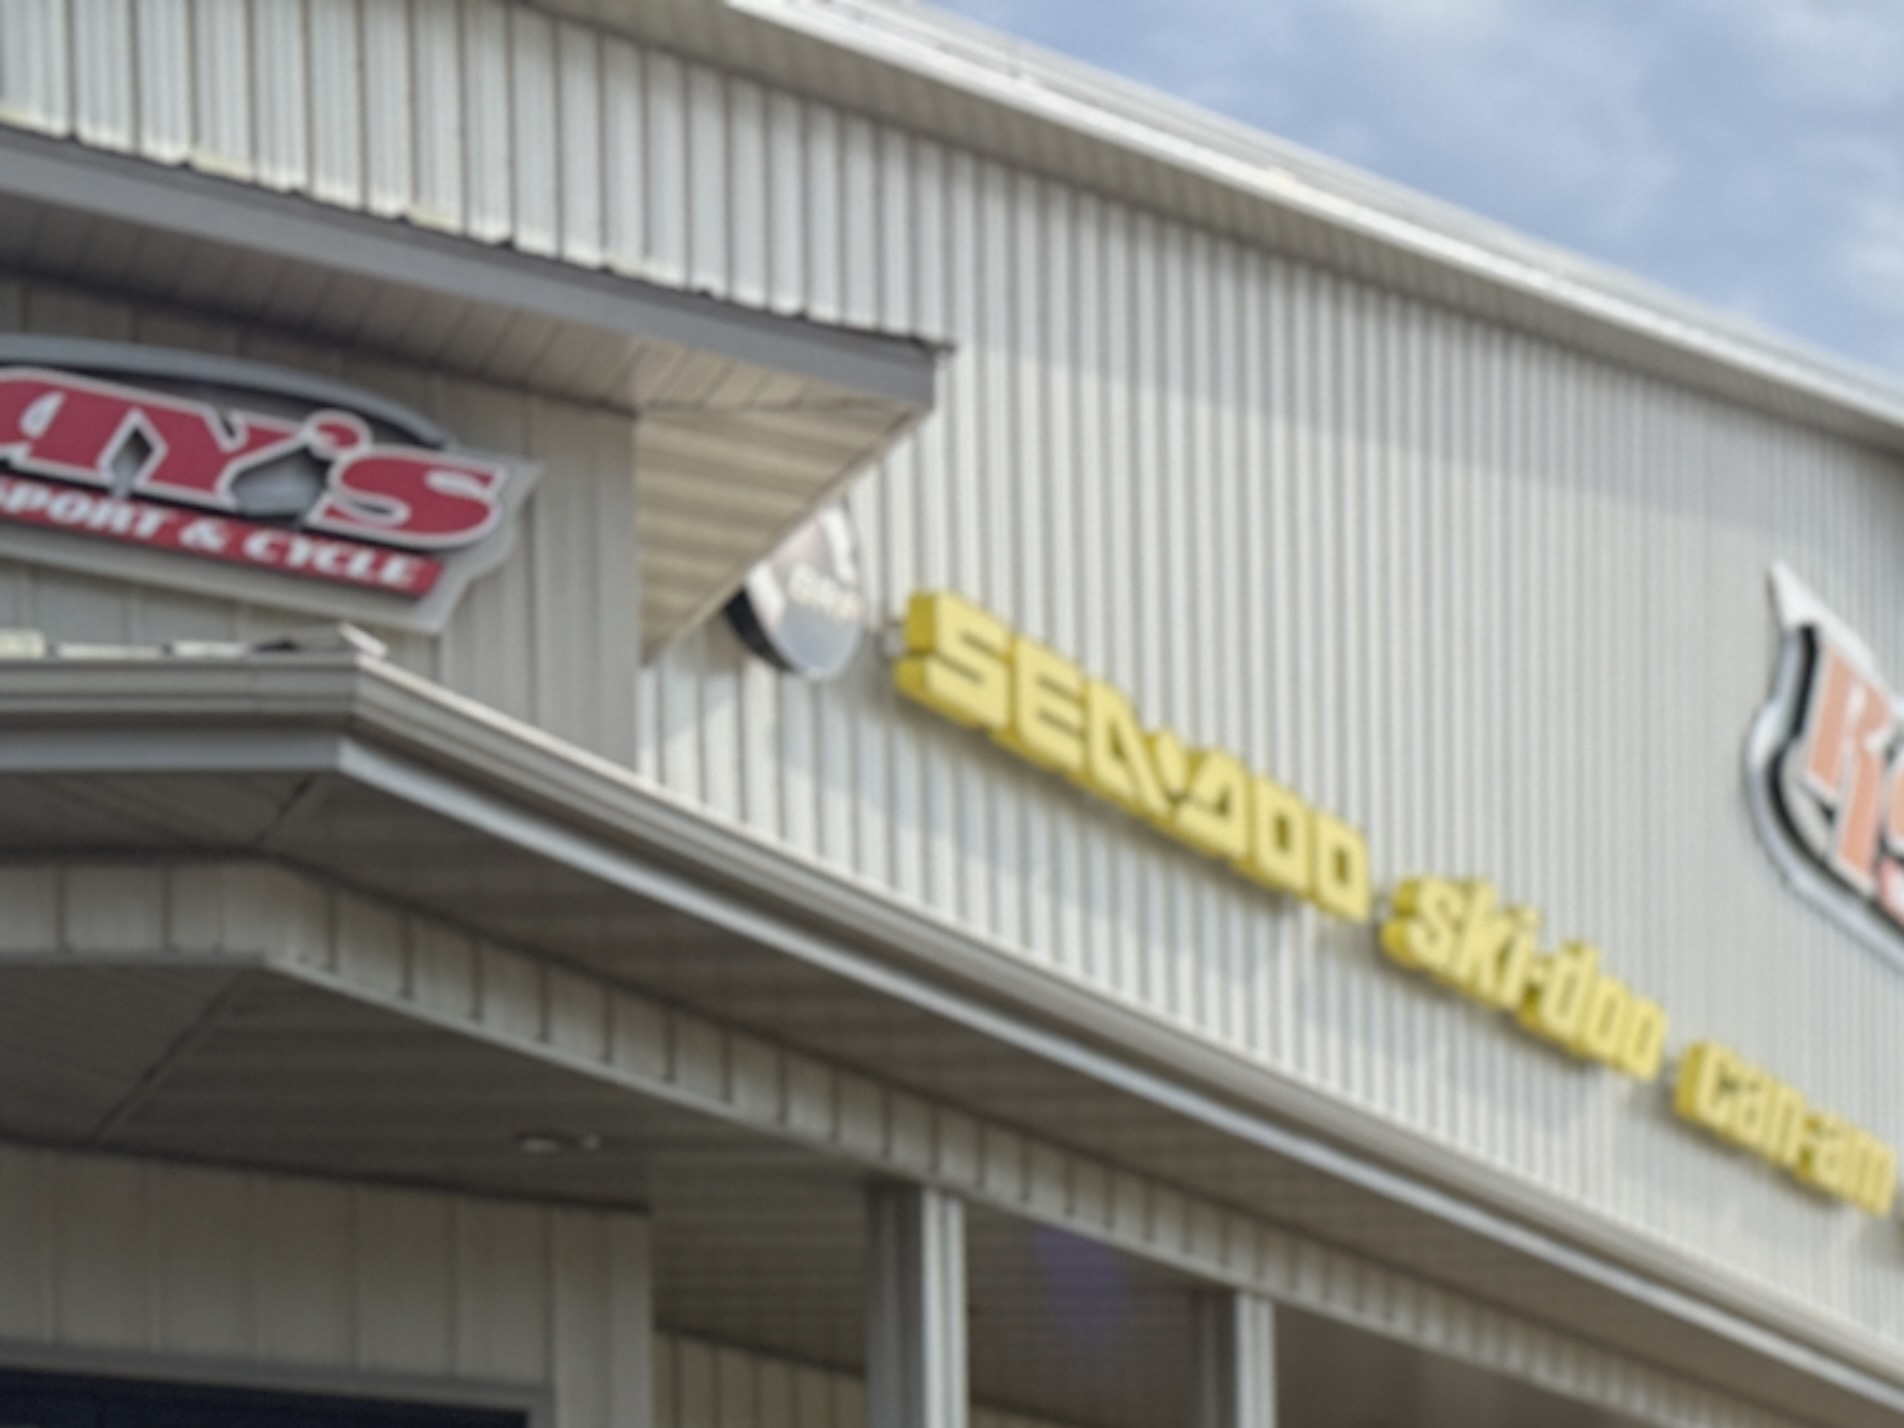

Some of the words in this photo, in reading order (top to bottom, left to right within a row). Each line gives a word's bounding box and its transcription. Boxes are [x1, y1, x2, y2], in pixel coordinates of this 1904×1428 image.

[0, 478, 178, 541] PORT
[178, 518, 226, 553] &
[242, 527, 428, 590] CYCLE
